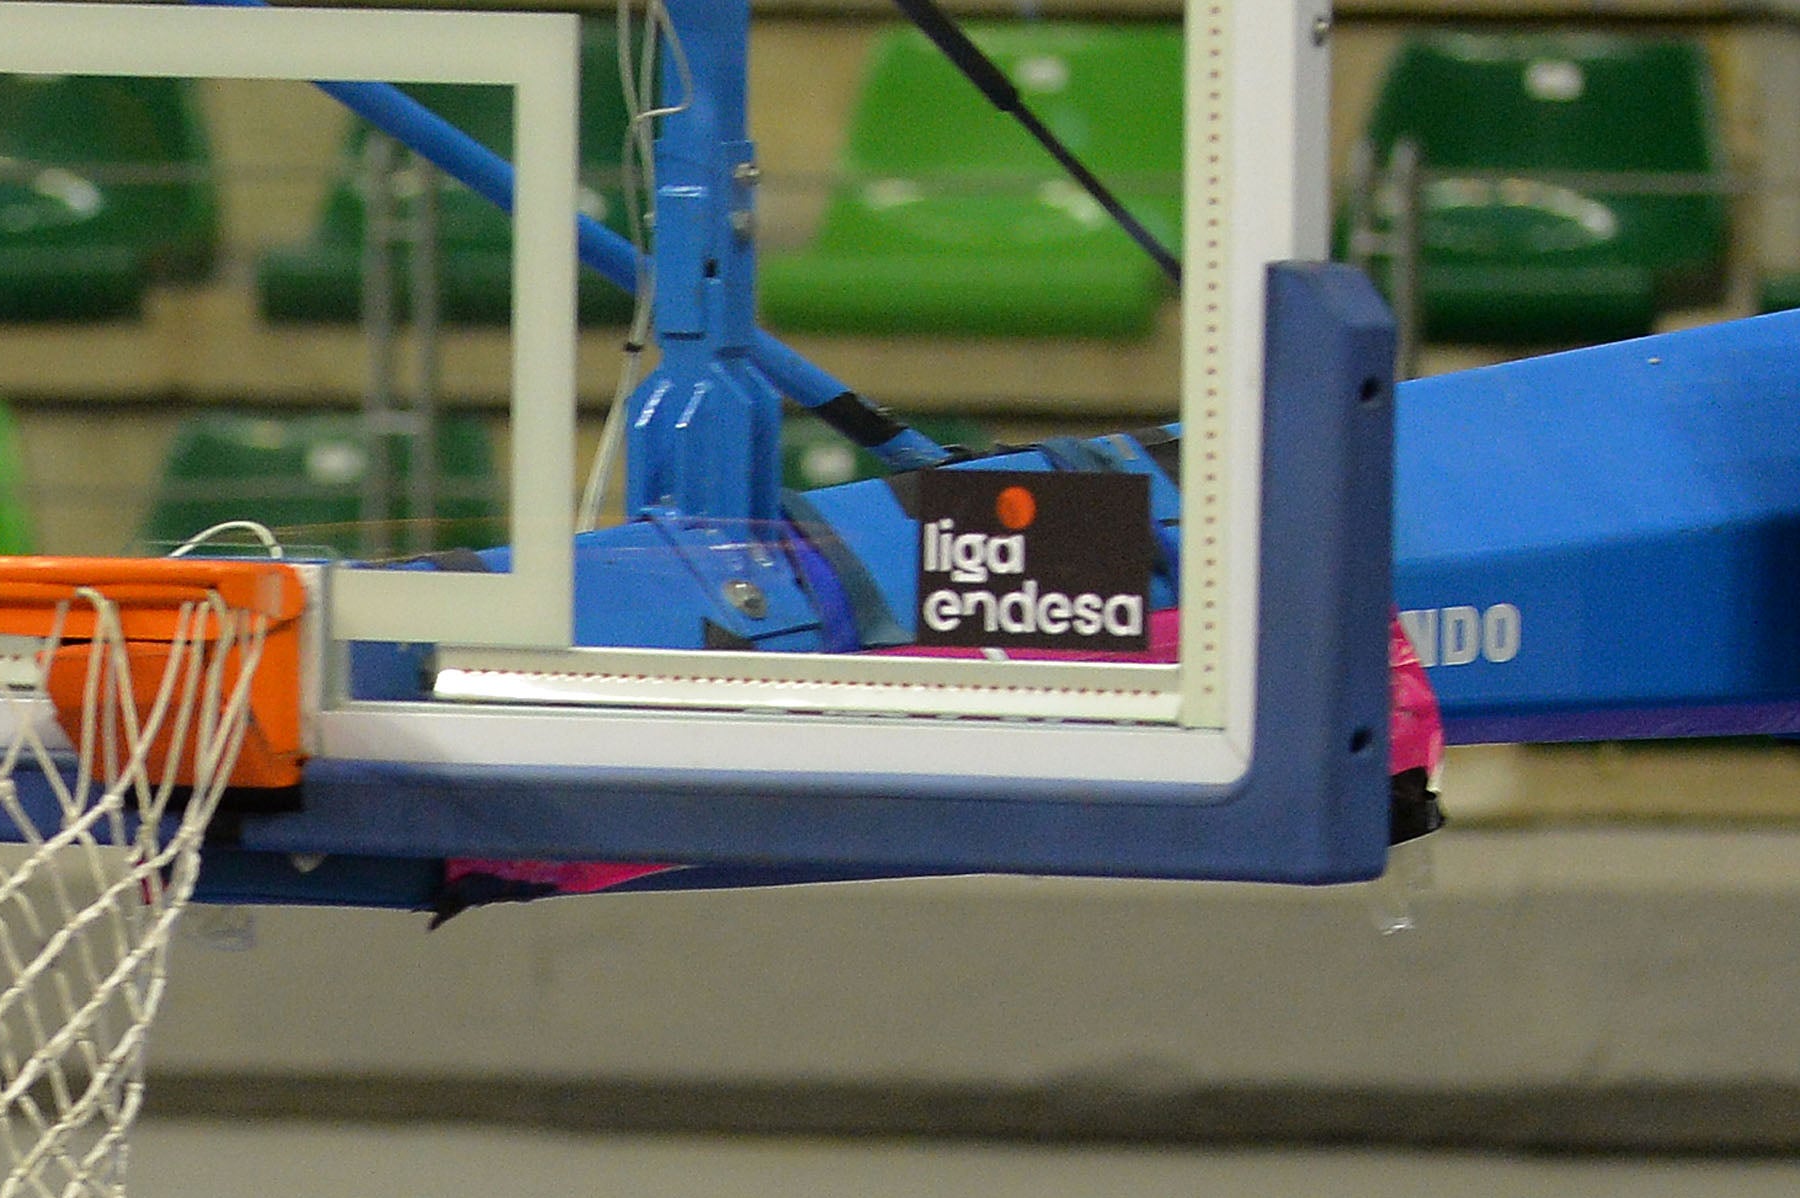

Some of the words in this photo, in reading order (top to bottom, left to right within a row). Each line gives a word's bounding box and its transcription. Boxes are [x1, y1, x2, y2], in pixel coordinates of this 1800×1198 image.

[923, 518, 1026, 583] liga
[922, 579, 1143, 637] endesa
[1399, 603, 1522, 668] NDO
